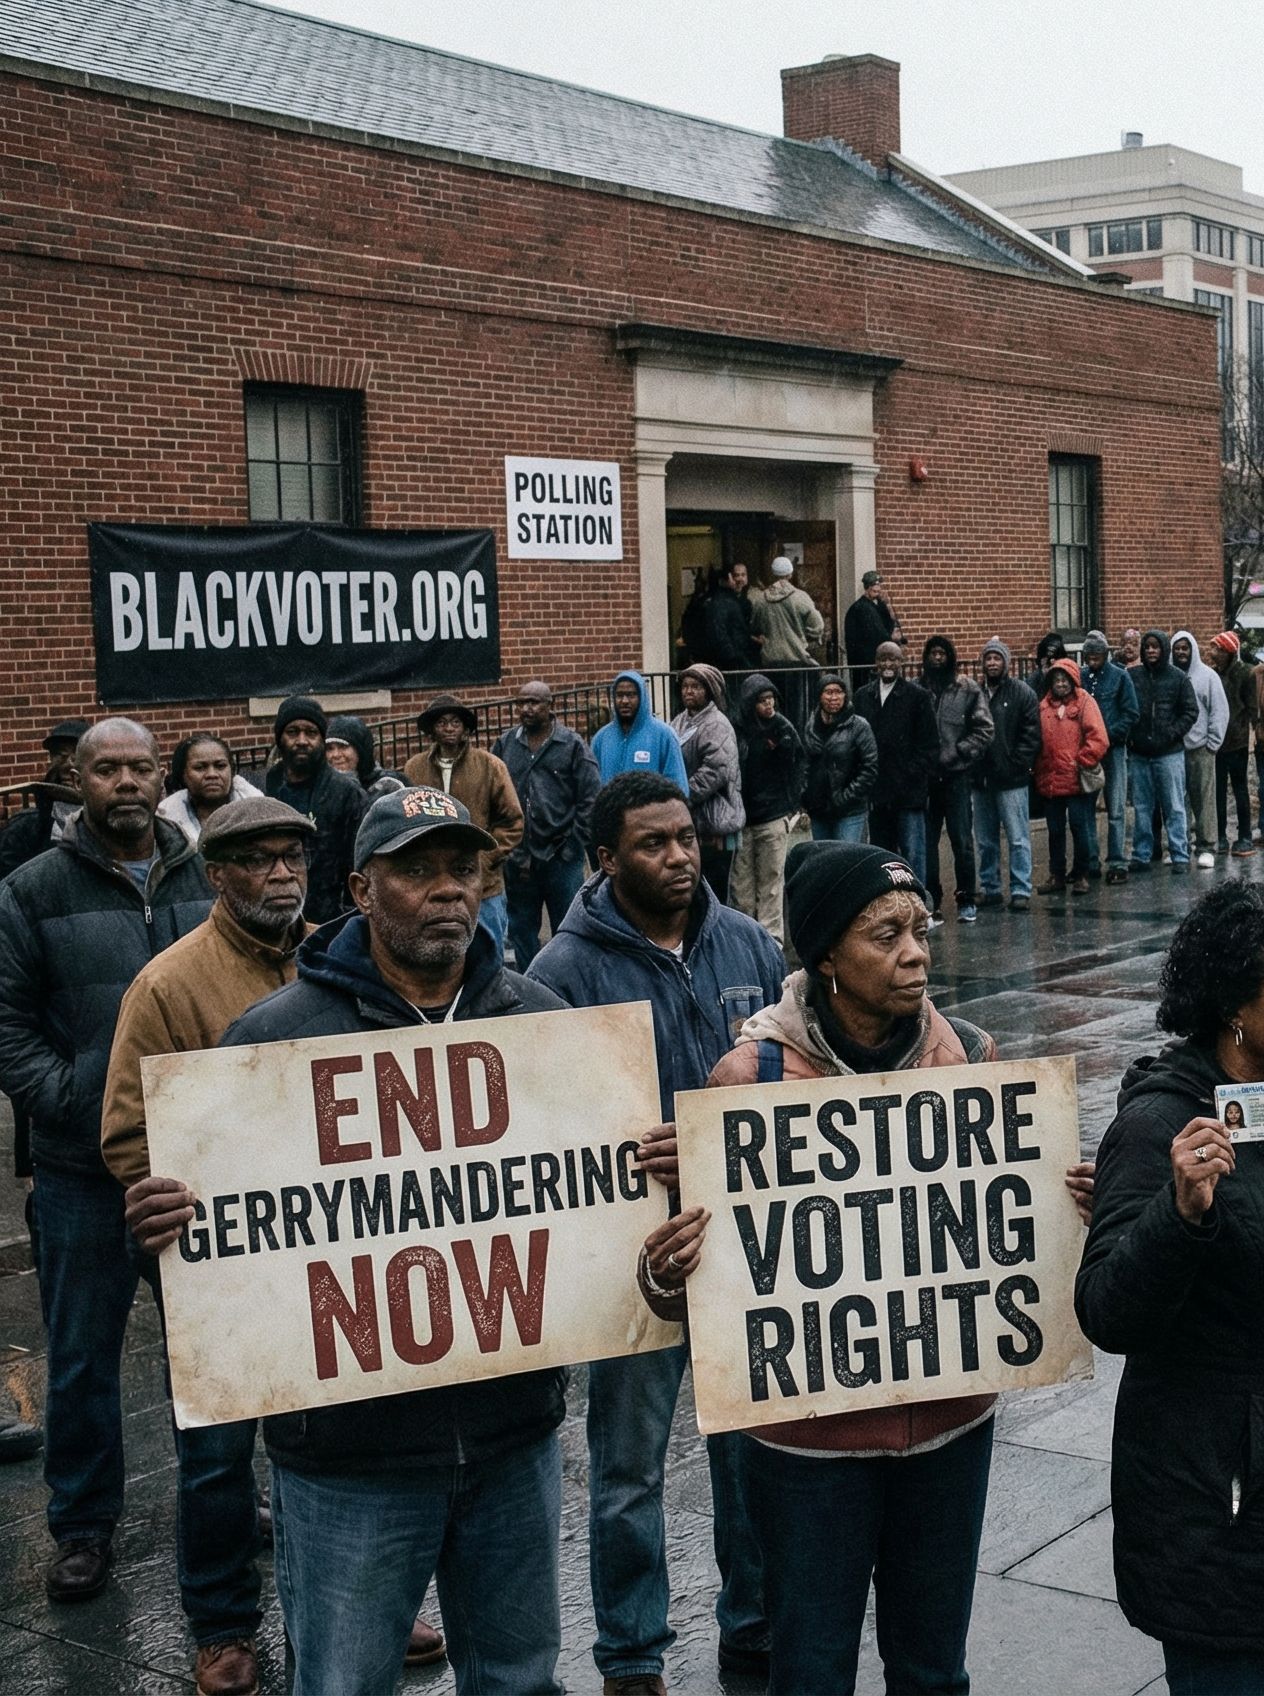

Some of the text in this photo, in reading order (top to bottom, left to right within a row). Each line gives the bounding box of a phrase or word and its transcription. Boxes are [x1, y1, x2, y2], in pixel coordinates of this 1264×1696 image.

[514, 471, 613, 506] POLLING
[516, 512, 613, 546] STATION
[109, 569, 488, 653] BLACKVOTER.ORG
[310, 1040, 510, 1166] END
[722, 1080, 1041, 1193] RESTORE
[177, 1140, 649, 1263] GERRYMANDERING
[732, 1173, 1036, 1297] VOTING
[306, 1228, 550, 1381] NOW
[745, 1274, 1043, 1402] RIGHTS
